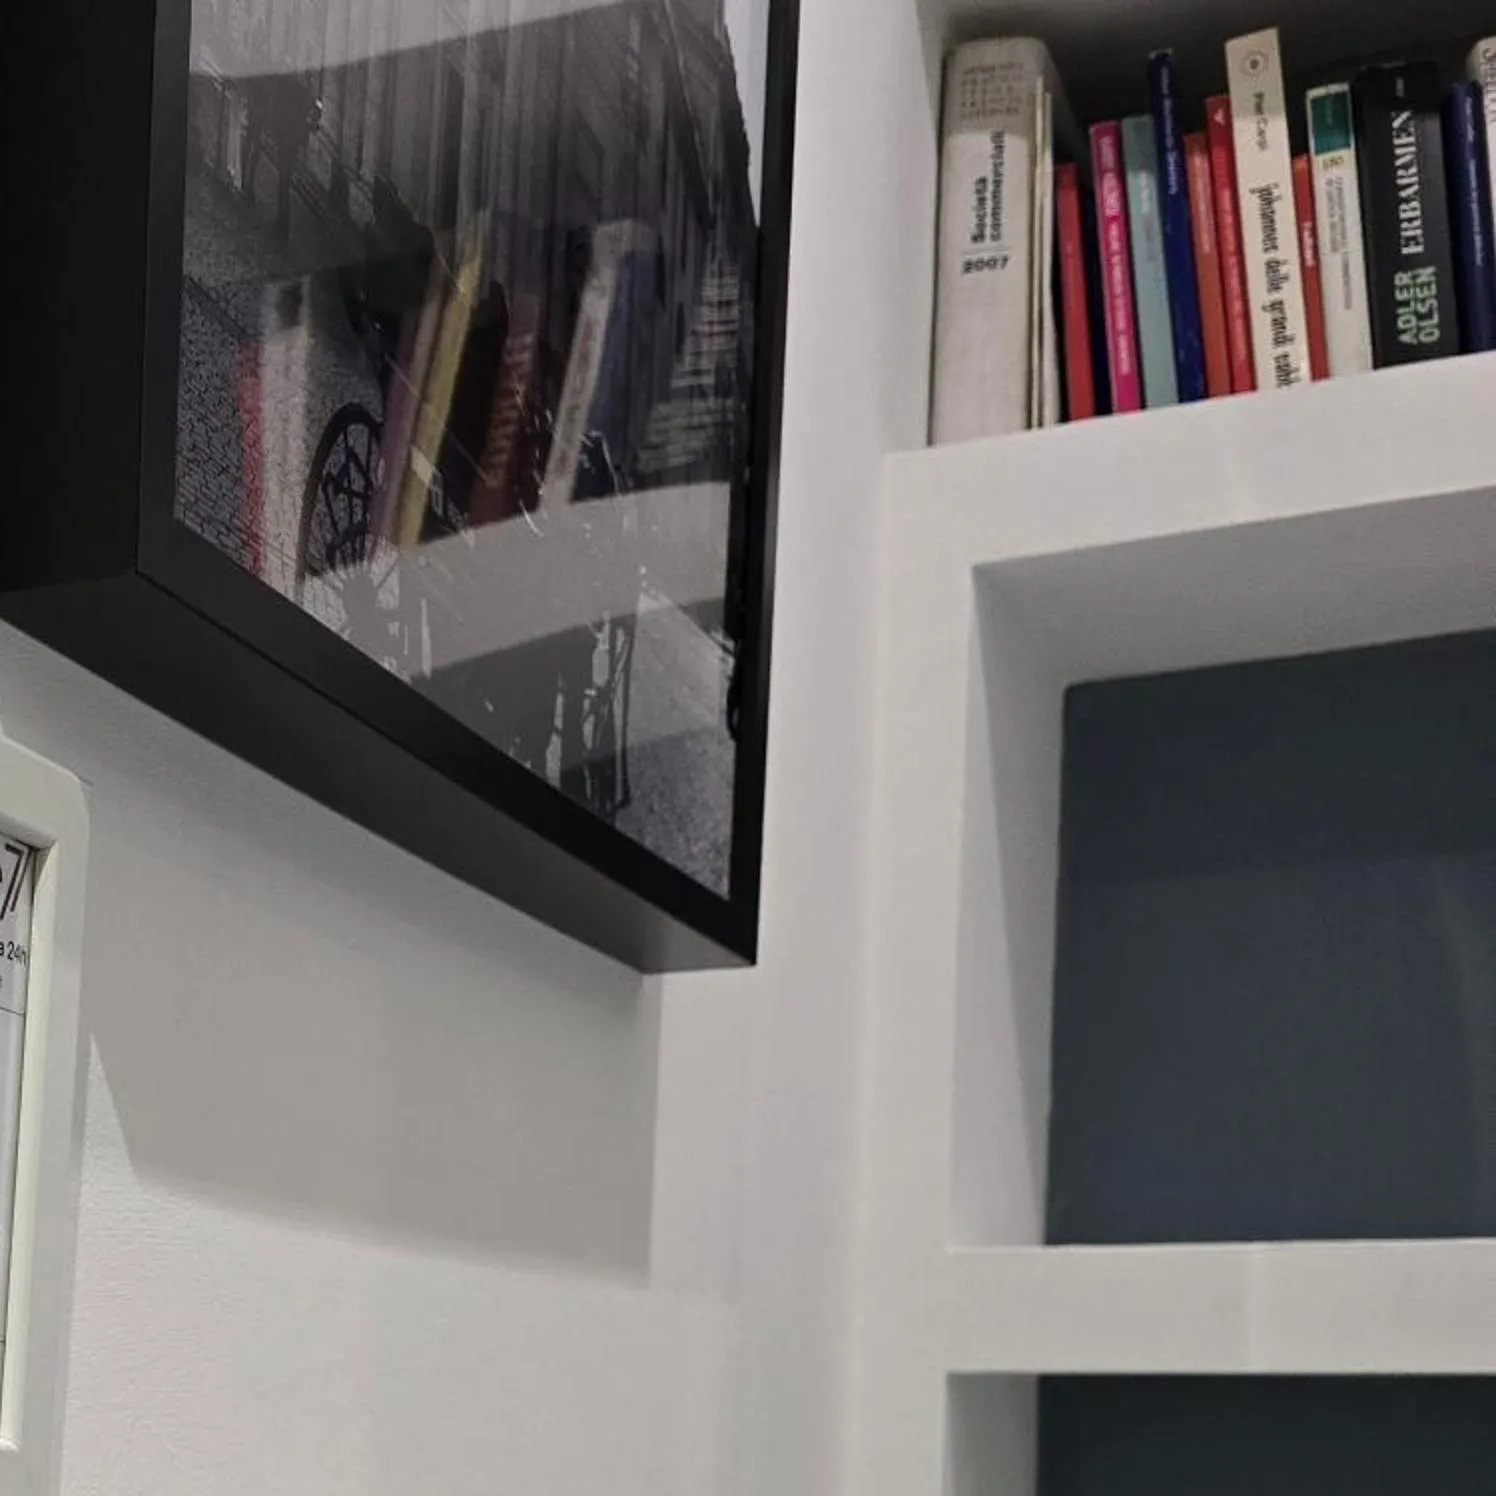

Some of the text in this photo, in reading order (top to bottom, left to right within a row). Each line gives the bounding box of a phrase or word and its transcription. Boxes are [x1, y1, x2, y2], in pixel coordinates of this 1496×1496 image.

[1391, 111, 1425, 254] ERBARMEN
[1394, 271, 1418, 345] ADLER
[1416, 266, 1440, 343] OLSEN
